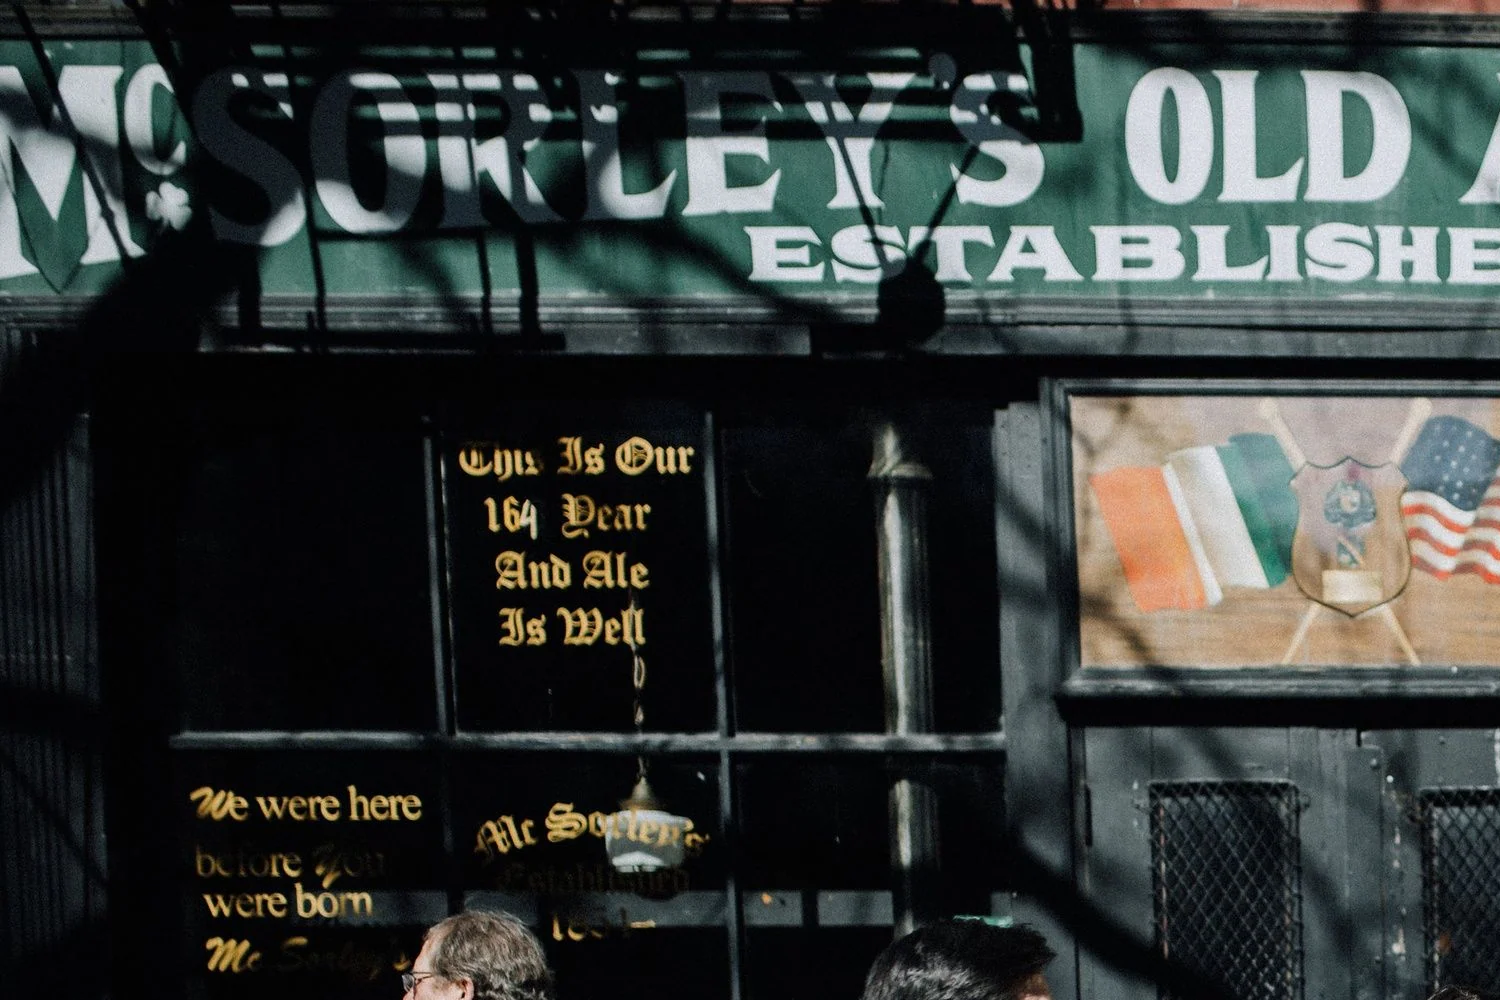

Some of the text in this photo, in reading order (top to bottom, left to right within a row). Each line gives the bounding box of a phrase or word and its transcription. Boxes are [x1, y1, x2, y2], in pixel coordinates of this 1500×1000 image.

[1125, 66, 1412, 205] OLD
[459, 436, 694, 481] This Is Our
[484, 493, 651, 540] 164 Year
[495, 550, 650, 590] And Ale
[499, 607, 646, 646] Is Well
[190, 784, 422, 821] We were here
[204, 882, 373, 918] were born
